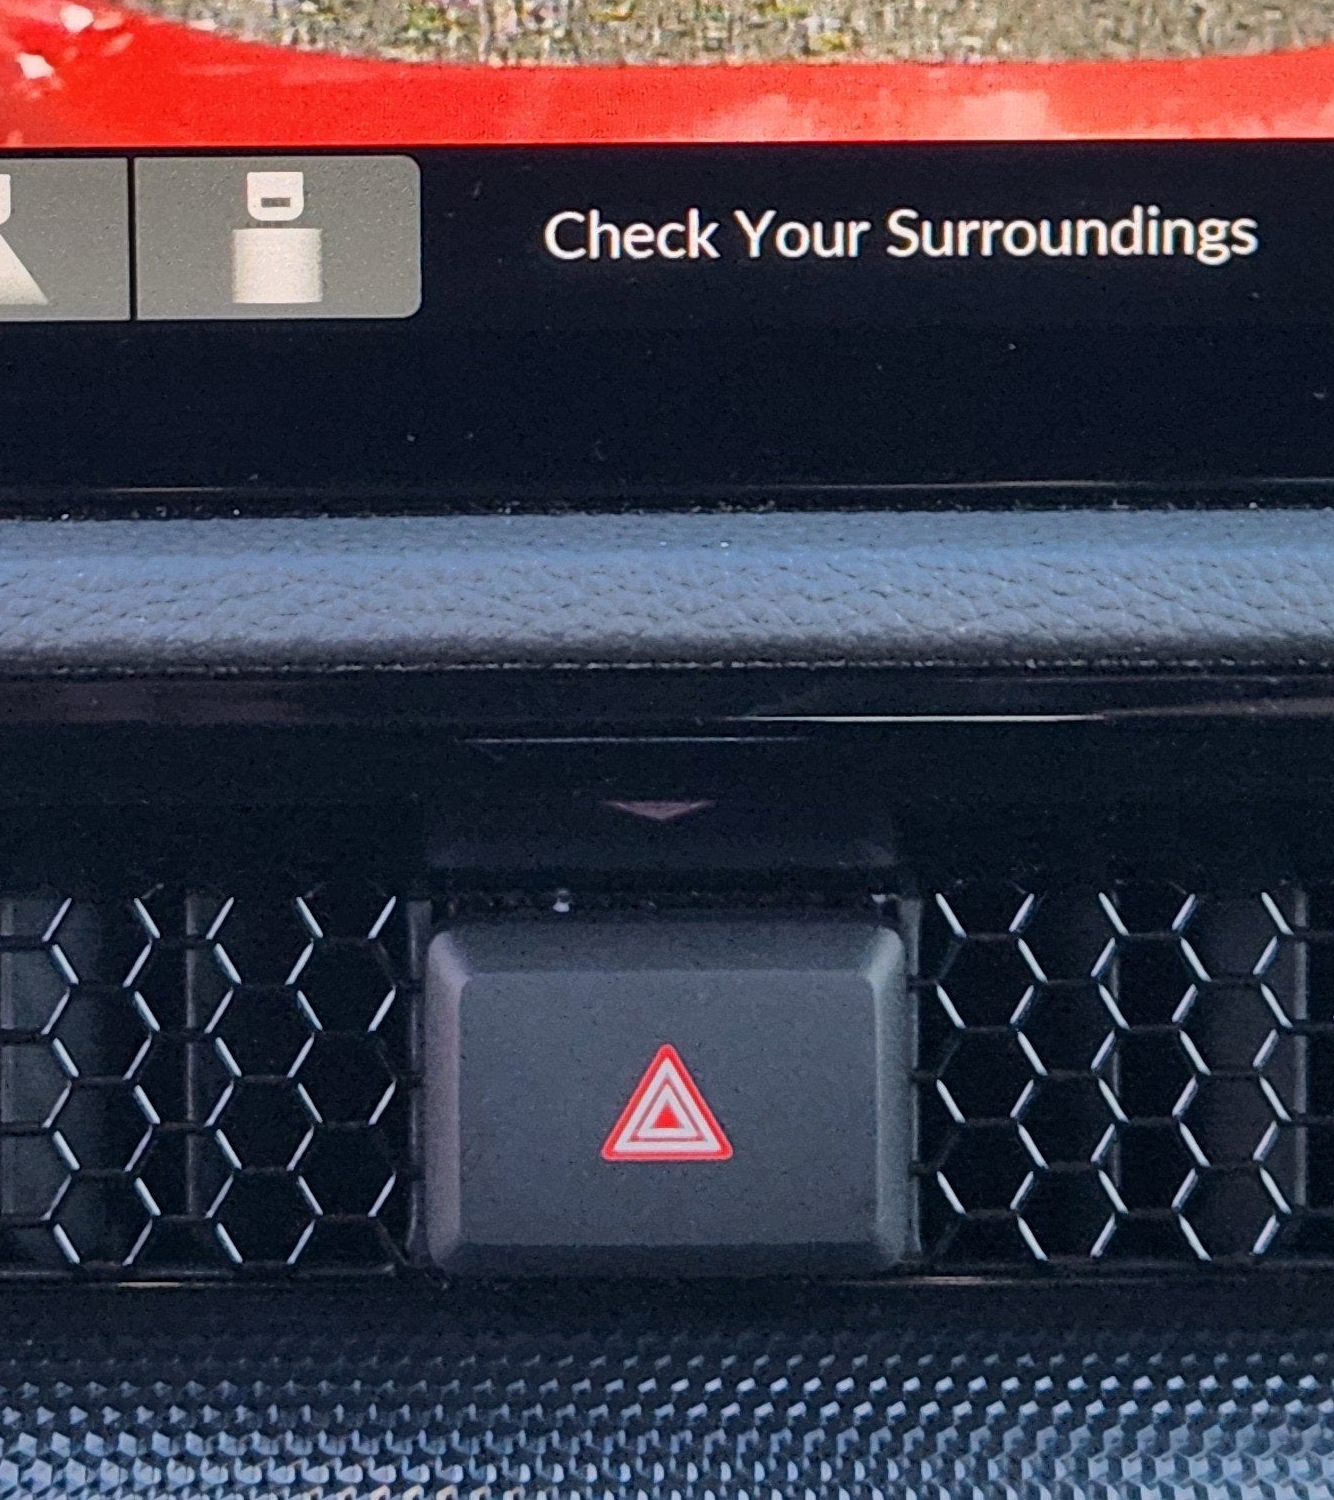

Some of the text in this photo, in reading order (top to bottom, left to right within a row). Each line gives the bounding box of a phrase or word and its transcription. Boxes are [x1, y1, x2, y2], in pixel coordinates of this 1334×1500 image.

[543, 204, 1259, 267] Check Your Surroundings
